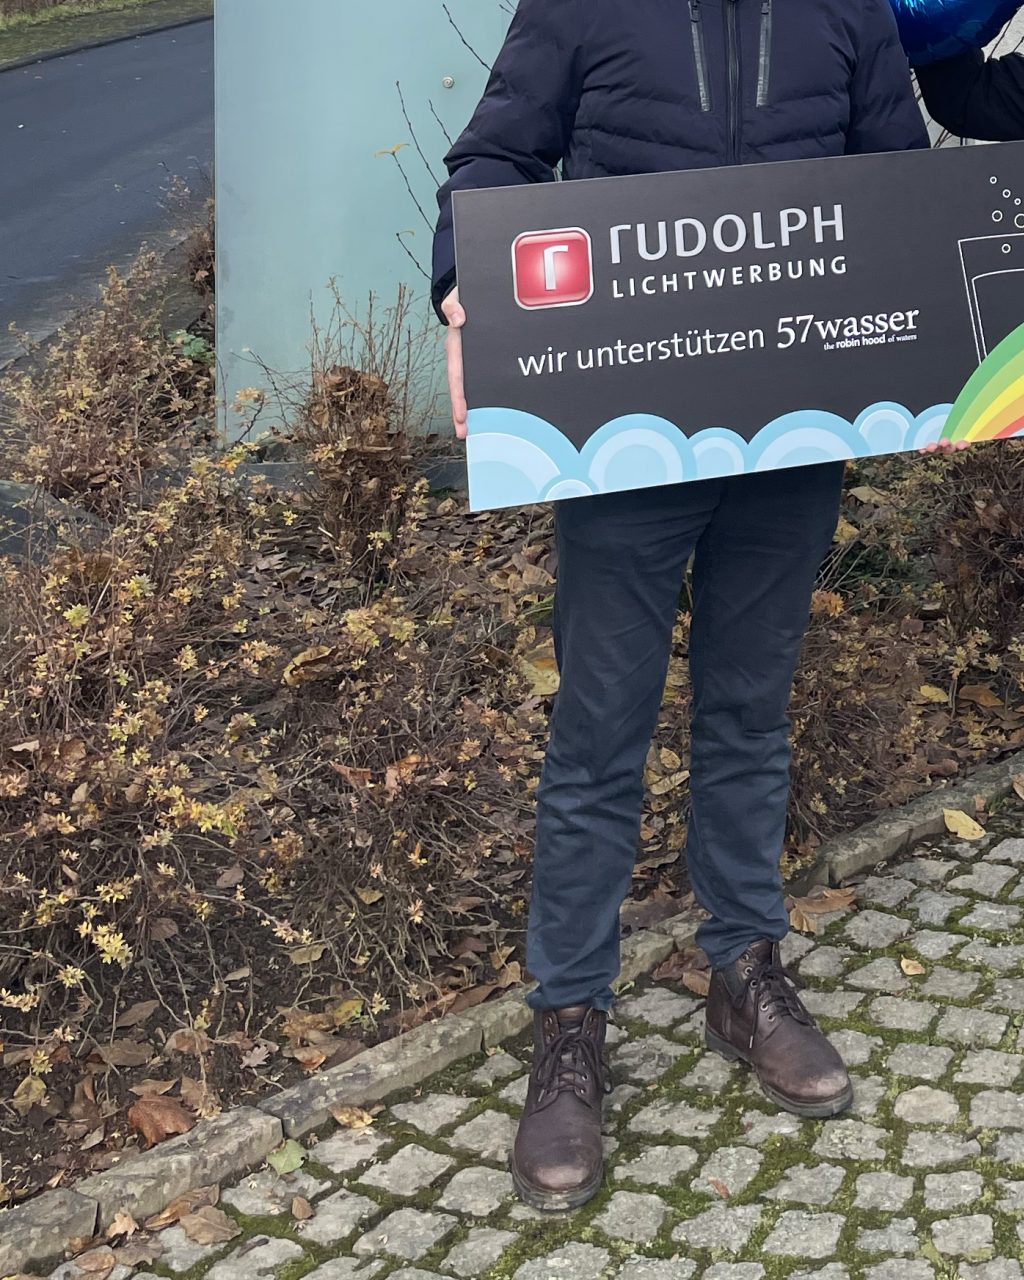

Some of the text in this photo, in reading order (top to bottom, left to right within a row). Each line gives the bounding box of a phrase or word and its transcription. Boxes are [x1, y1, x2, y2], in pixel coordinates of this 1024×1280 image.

[612, 255, 847, 299] LICHTWERBUNG
[517, 309, 919, 377] wir unterstützen 57wasser
[823, 342, 835, 351] the
[836, 338, 860, 349] robin
[861, 333, 886, 346] hood
[887, 334, 896, 342] of
